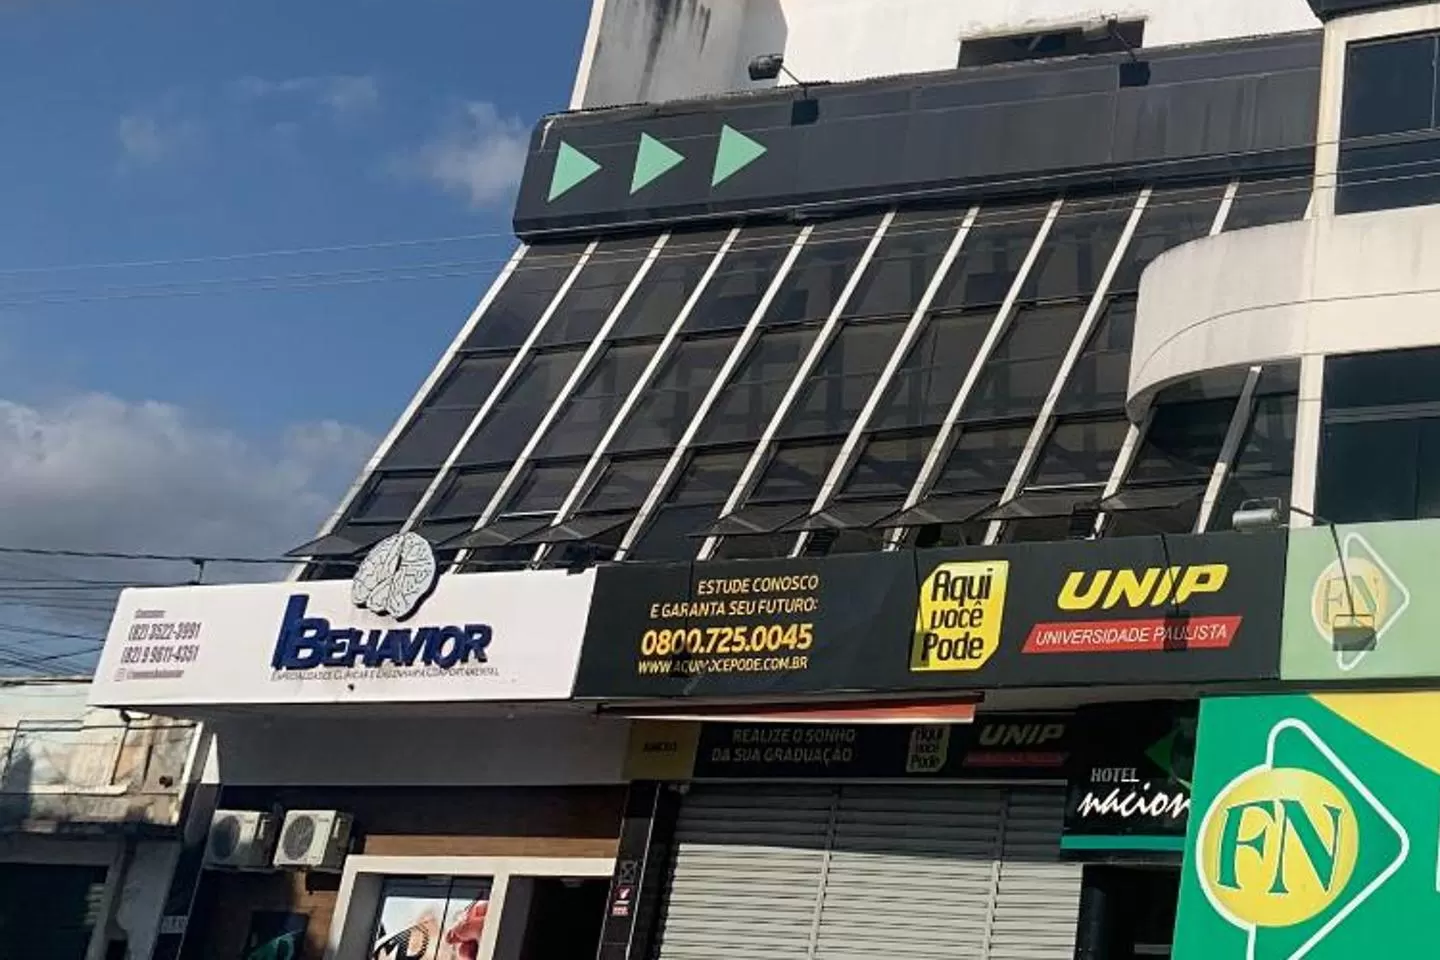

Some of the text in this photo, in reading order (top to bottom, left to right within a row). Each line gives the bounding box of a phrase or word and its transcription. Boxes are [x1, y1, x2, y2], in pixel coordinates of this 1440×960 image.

[697, 575, 820, 596] ESTUDE CONOSCO
[931, 568, 993, 607] Aqui
[1057, 563, 1230, 611] UNIP
[650, 597, 820, 619] E GARANTA SEU FUTURO:
[930, 601, 982, 629] você
[641, 623, 814, 656] 0800.725.0045
[1036, 623, 1227, 646] UNIVERSIDADE PAULISTA
[921, 632, 983, 661] Pode
[732, 728, 791, 745] REALIZE
[805, 727, 857, 744] SONHO
[979, 723, 1065, 746] UNIP
[711, 747, 730, 762] DA
[732, 747, 761, 762] SUA
[1090, 767, 1141, 783] HOTEL
[1214, 796, 1345, 898] FN
